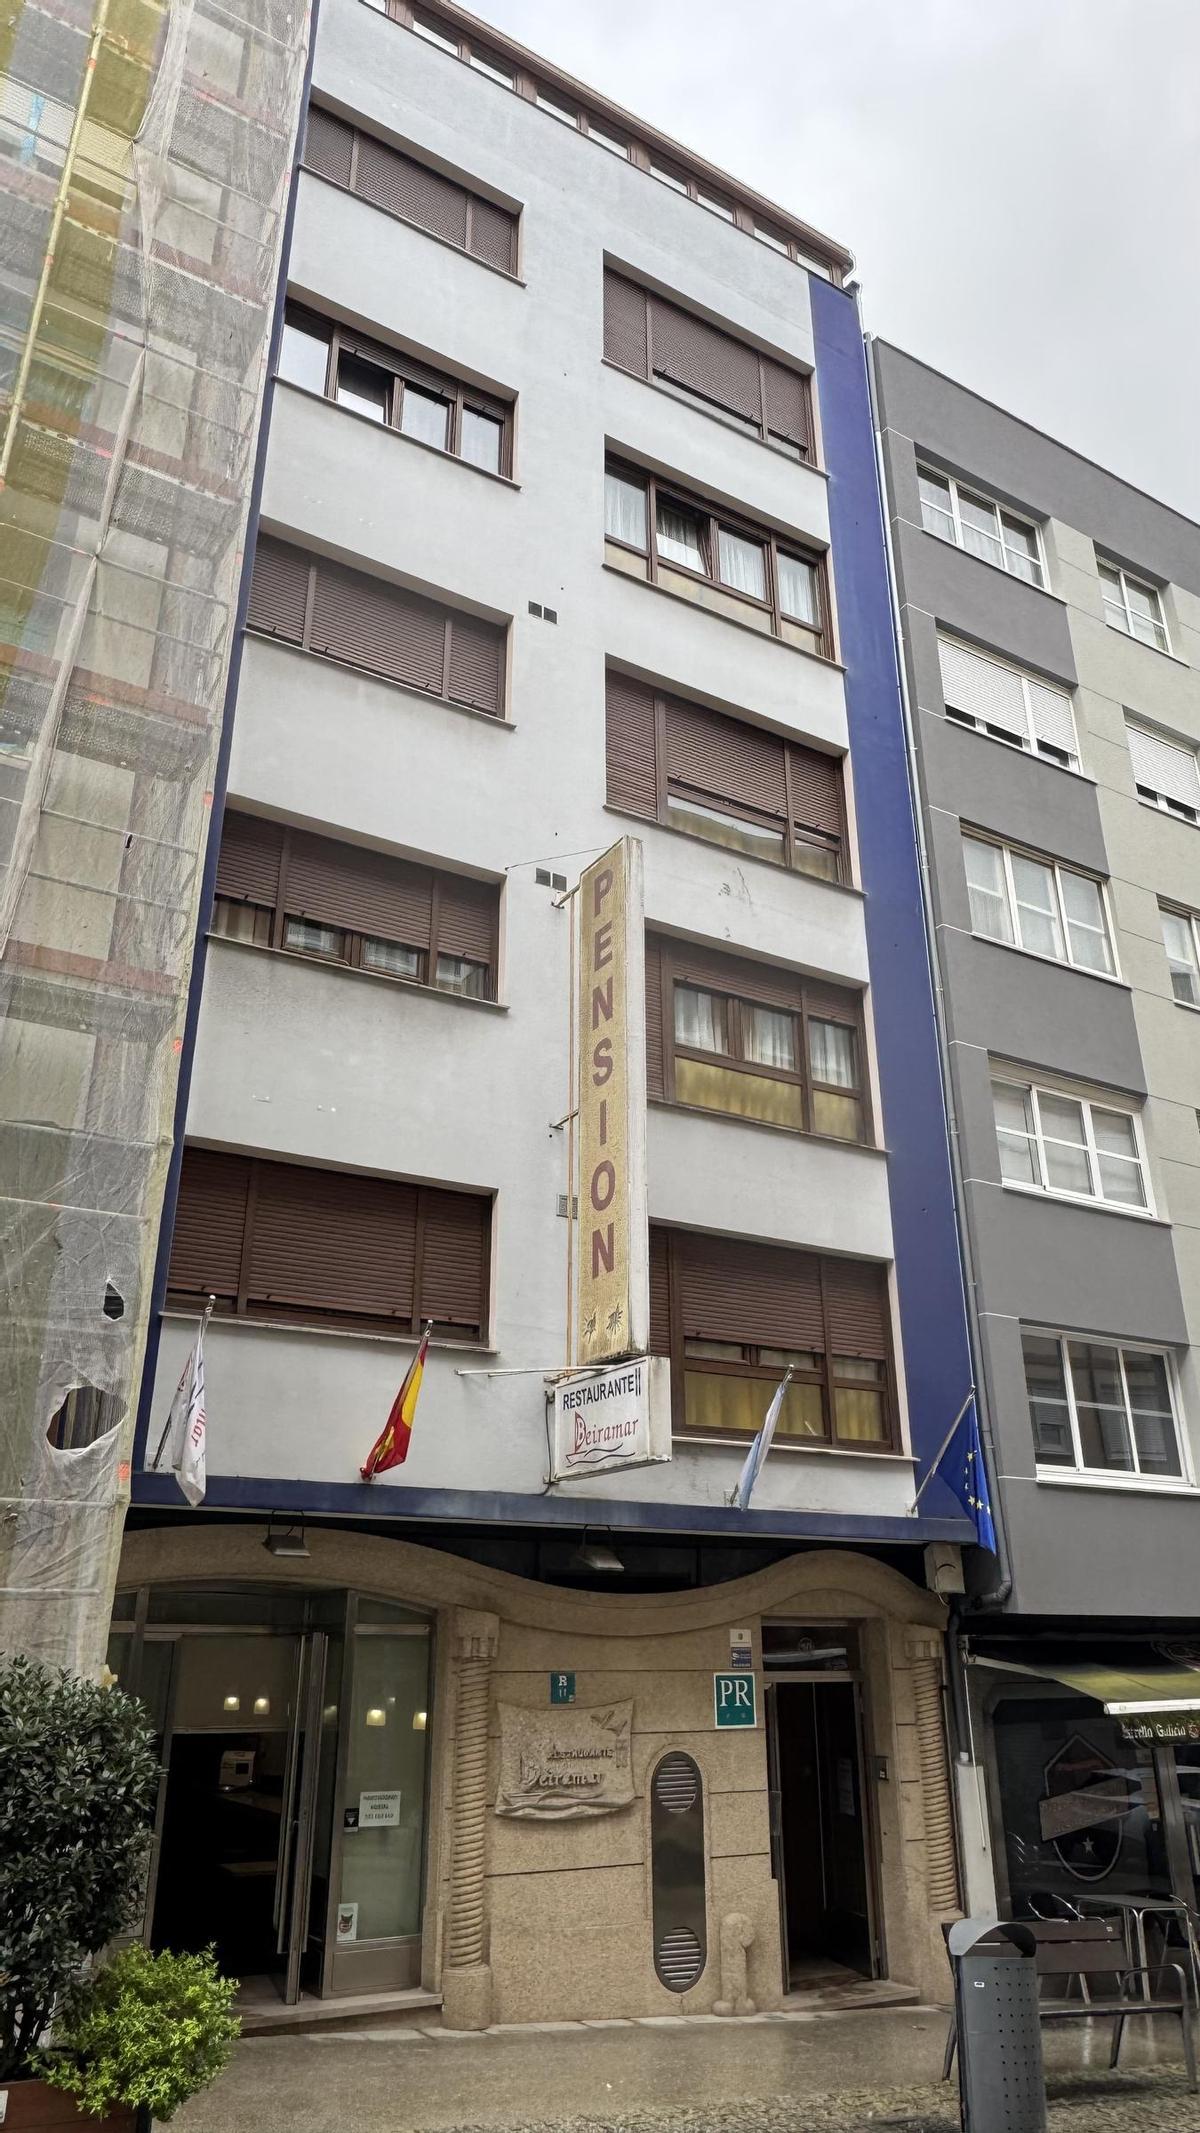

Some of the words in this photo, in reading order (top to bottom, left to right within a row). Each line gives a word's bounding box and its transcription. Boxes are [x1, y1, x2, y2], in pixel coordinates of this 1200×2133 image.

[590, 868, 615, 1280] PENSION
[563, 1374, 634, 1411] RESTAURANTE
[575, 1411, 639, 1454] Beiramar
[720, 1680, 751, 1707] PR
[1156, 1723, 1186, 1738] Galicia
